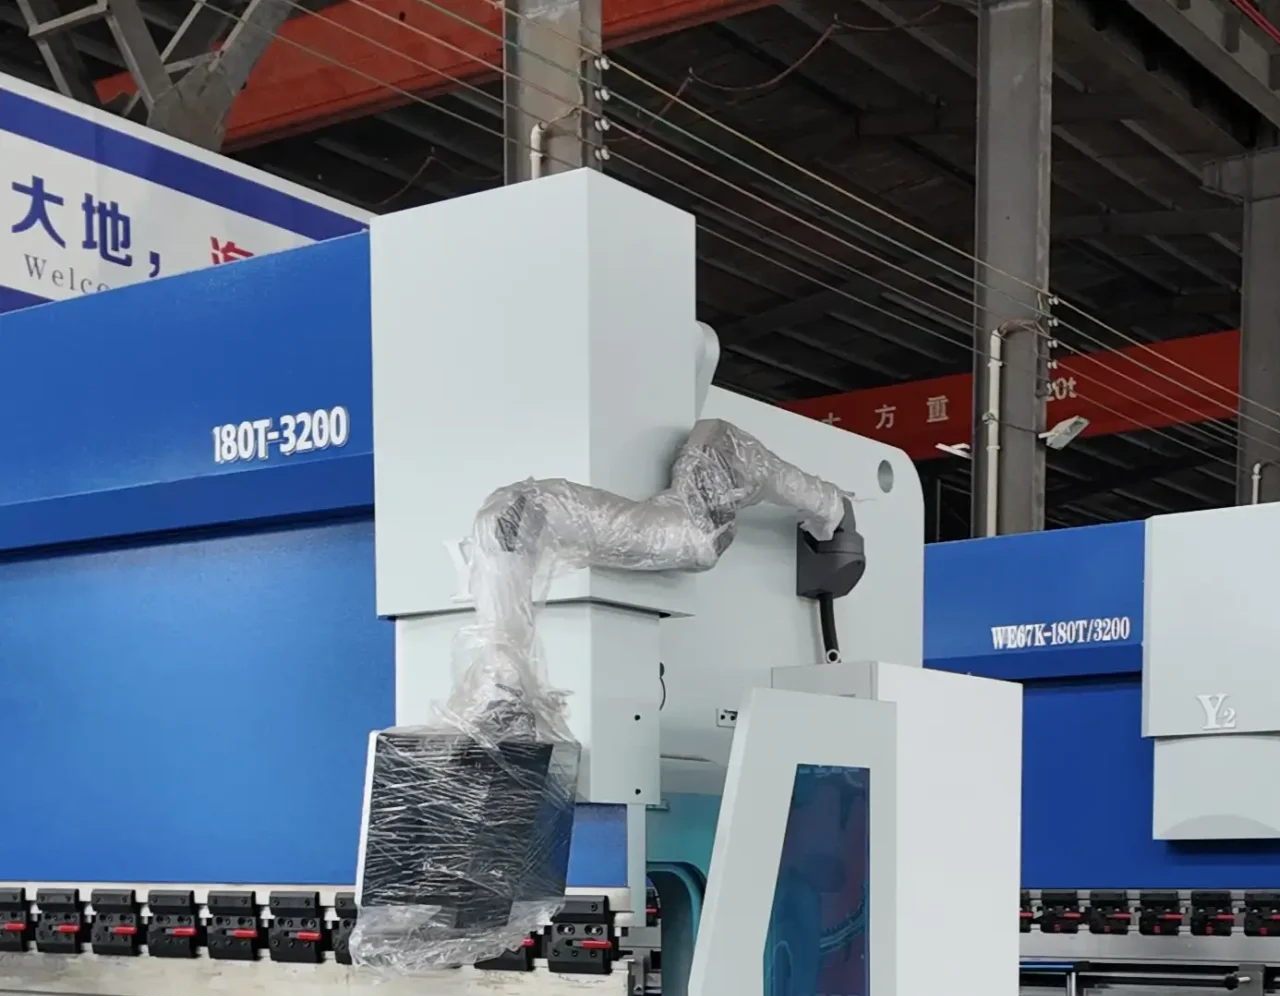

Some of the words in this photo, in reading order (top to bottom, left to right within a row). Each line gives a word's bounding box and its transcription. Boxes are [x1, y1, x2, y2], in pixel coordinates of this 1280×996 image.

[211, 405, 349, 464] 180T-3200
[990, 616, 1131, 650] WE67K-180T/3200
[1196, 693, 1237, 730] Y2
